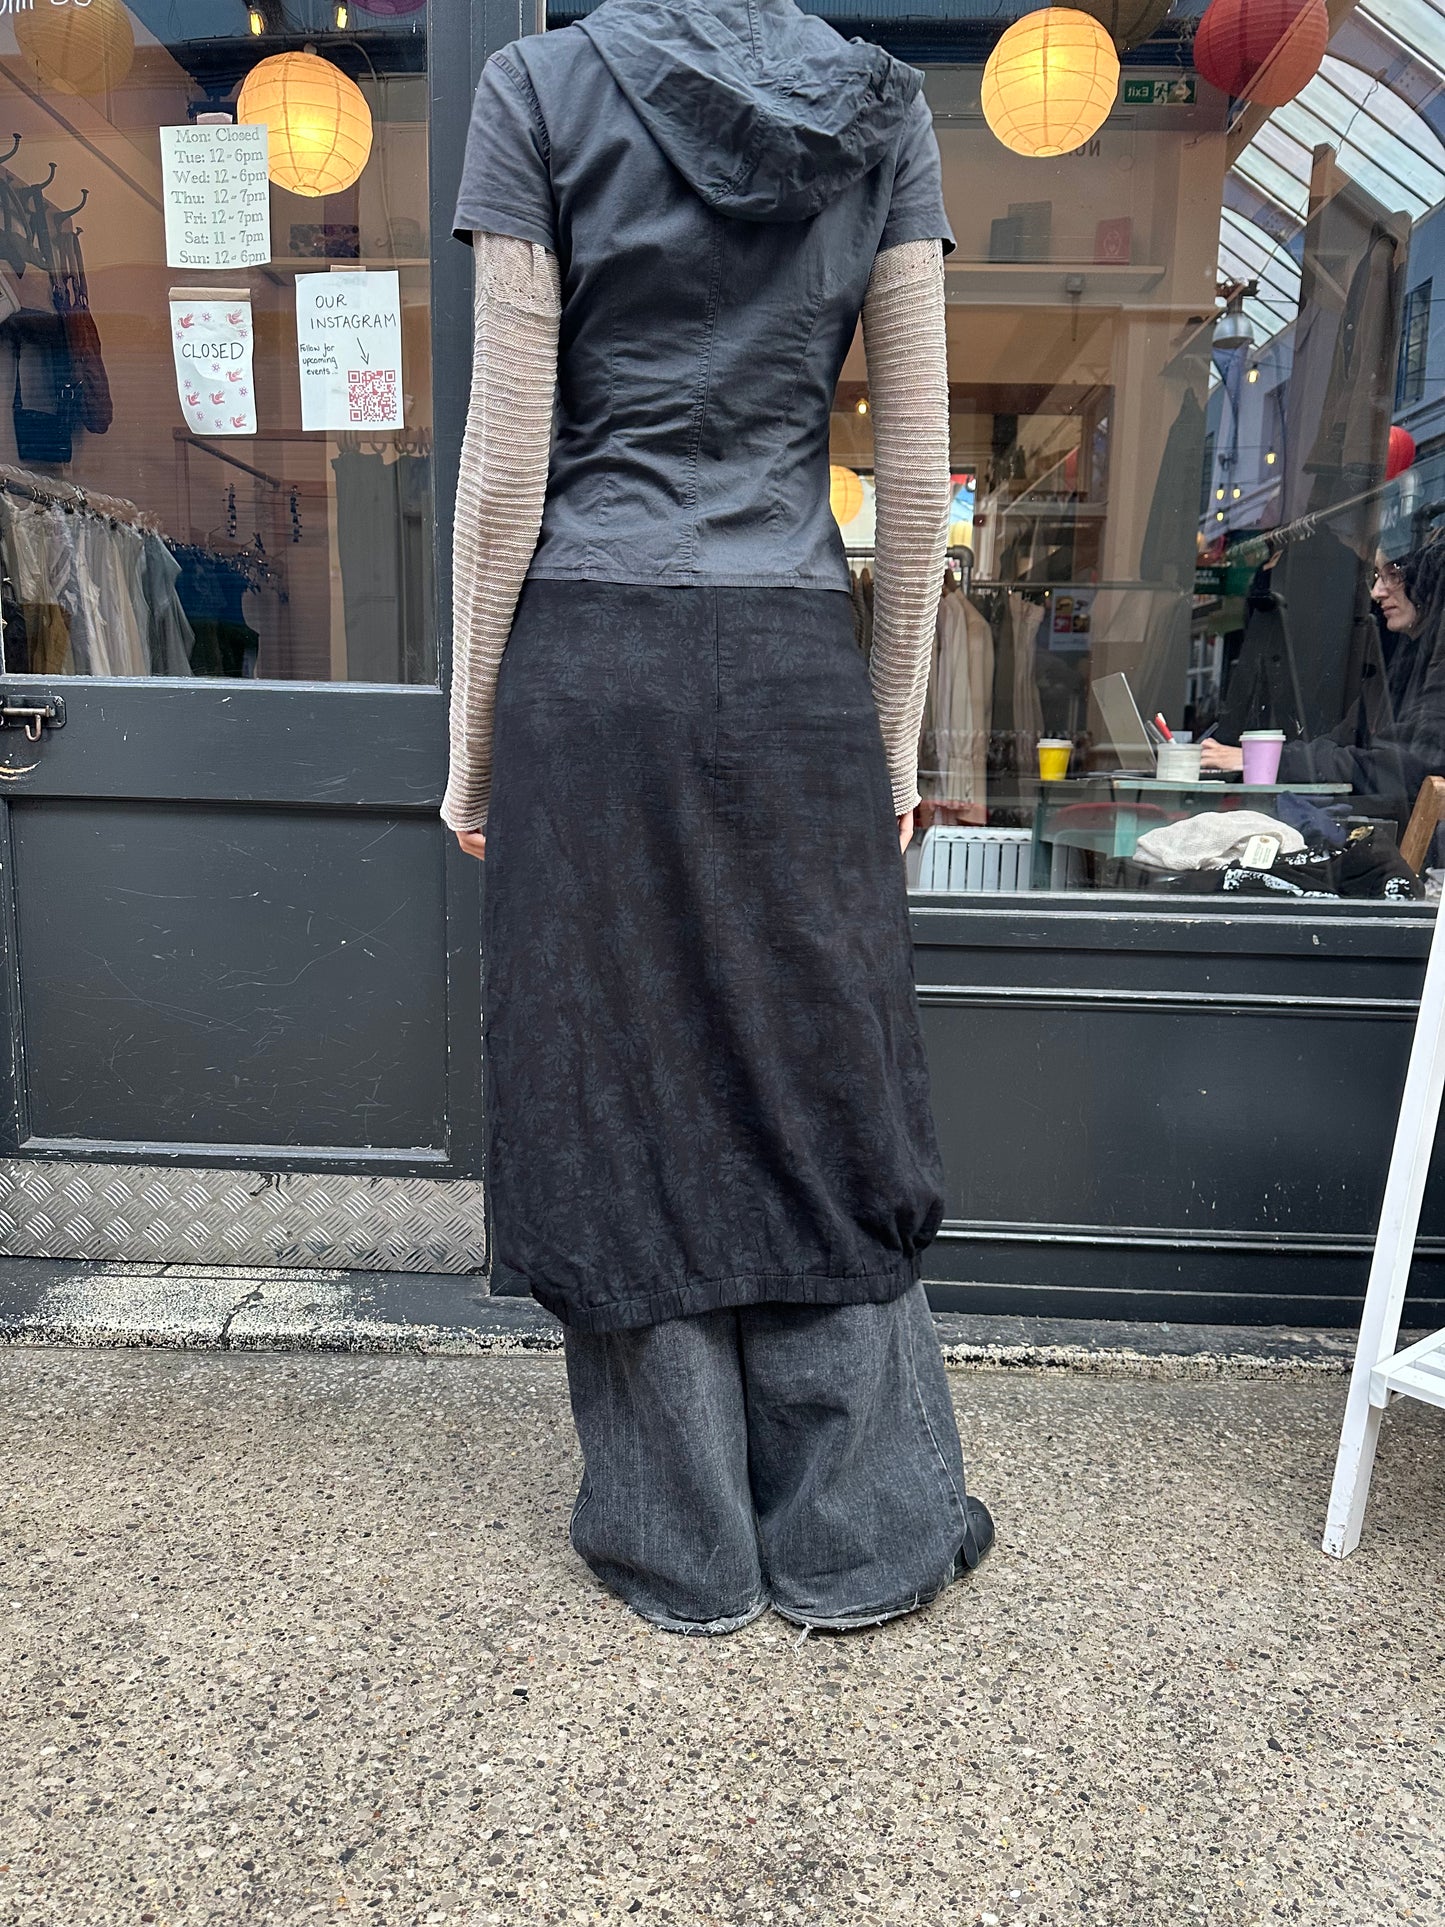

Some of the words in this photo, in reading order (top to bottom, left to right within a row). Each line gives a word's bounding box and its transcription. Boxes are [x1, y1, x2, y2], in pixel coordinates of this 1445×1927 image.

[176, 129, 211, 143] Mon:
[215, 127, 260, 142] Closed
[174, 150, 205, 164] Tue:
[172, 170, 210, 184] Wed:
[170, 190, 205, 204] Thu:
[183, 211, 207, 225] Fri:
[184, 230, 210, 245] Sat:
[179, 250, 210, 264] Sun:
[315, 293, 347, 309] OUR
[310, 313, 397, 330] INSTAGRAM
[182, 342, 244, 360] CLOSED
[300, 343, 320, 353] Follow
[322, 342, 335, 358] for
[302, 356, 339, 370] upcoming
